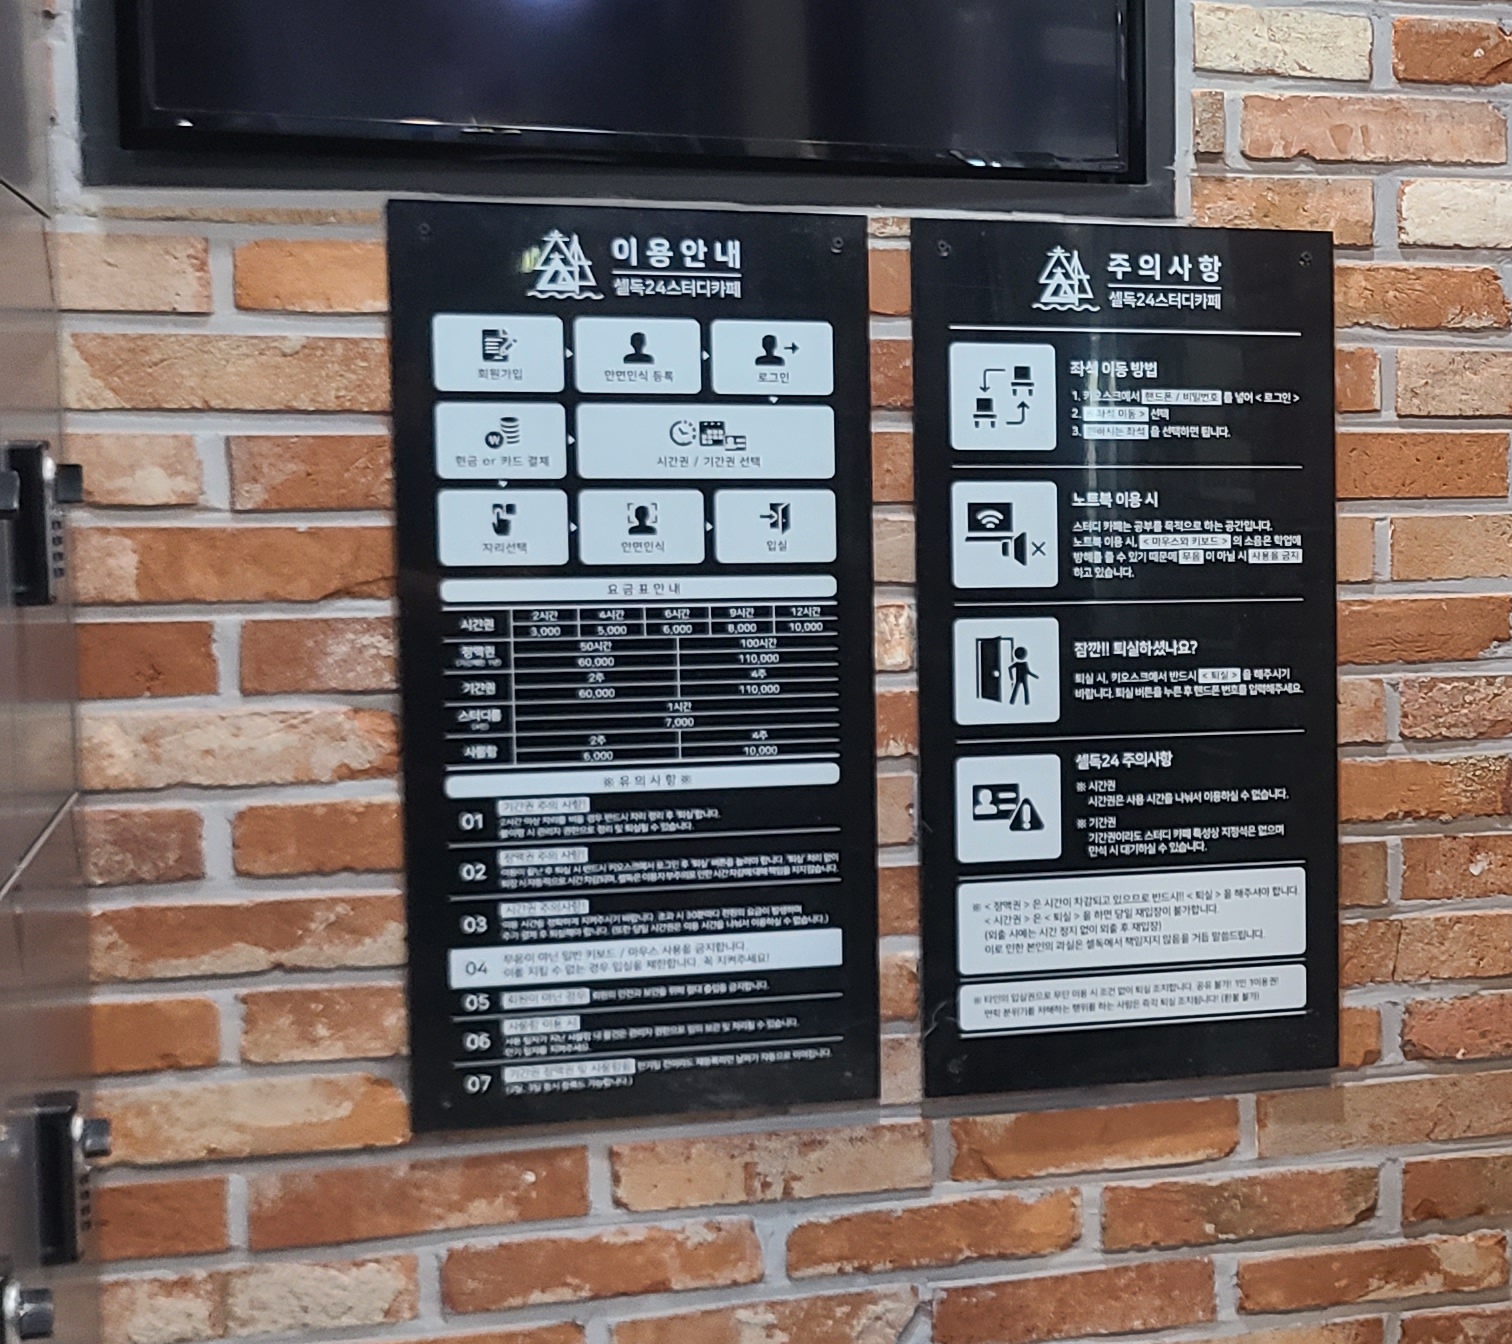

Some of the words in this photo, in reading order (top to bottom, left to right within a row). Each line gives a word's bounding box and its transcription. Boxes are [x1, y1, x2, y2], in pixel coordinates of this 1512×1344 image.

[613, 278, 742, 299] 셀독24스터디카페
[1108, 292, 1222, 310] 셀독24스터디카페
[477, 368, 523, 380] 회원가입
[604, 370, 649, 382] 안면인식
[653, 371, 673, 382] 등록
[757, 372, 790, 383] 로그인
[1070, 362, 1095, 378] 좌석
[1102, 362, 1129, 378] 이동
[1131, 362, 1158, 378] 방법
[483, 457, 496, 466] or
[501, 455, 522, 467] 카드
[657, 456, 689, 468] 시간권
[703, 455, 734, 468] 기간권
[739, 455, 760, 467] 선택
[1072, 492, 1113, 508] 노트북
[1115, 493, 1142, 508] 이용
[1146, 492, 1159, 508] 시
[483, 542, 528, 553] 자리선택
[621, 541, 665, 552] 안면인식
[766, 539, 787, 552] 입실
[740, 638, 777, 649] 100시간
[738, 653, 779, 665] 110,000
[665, 716, 694, 728] 7,000
[1076, 753, 1120, 770] 셀독24
[1123, 751, 1173, 768] 주의사항
[460, 813, 484, 831] 01
[460, 863, 486, 881] 02
[463, 916, 488, 934] 03
[465, 961, 488, 976] 04
[465, 994, 491, 1011] 05
[465, 1034, 492, 1051] 06
[466, 1075, 493, 1094] 07
